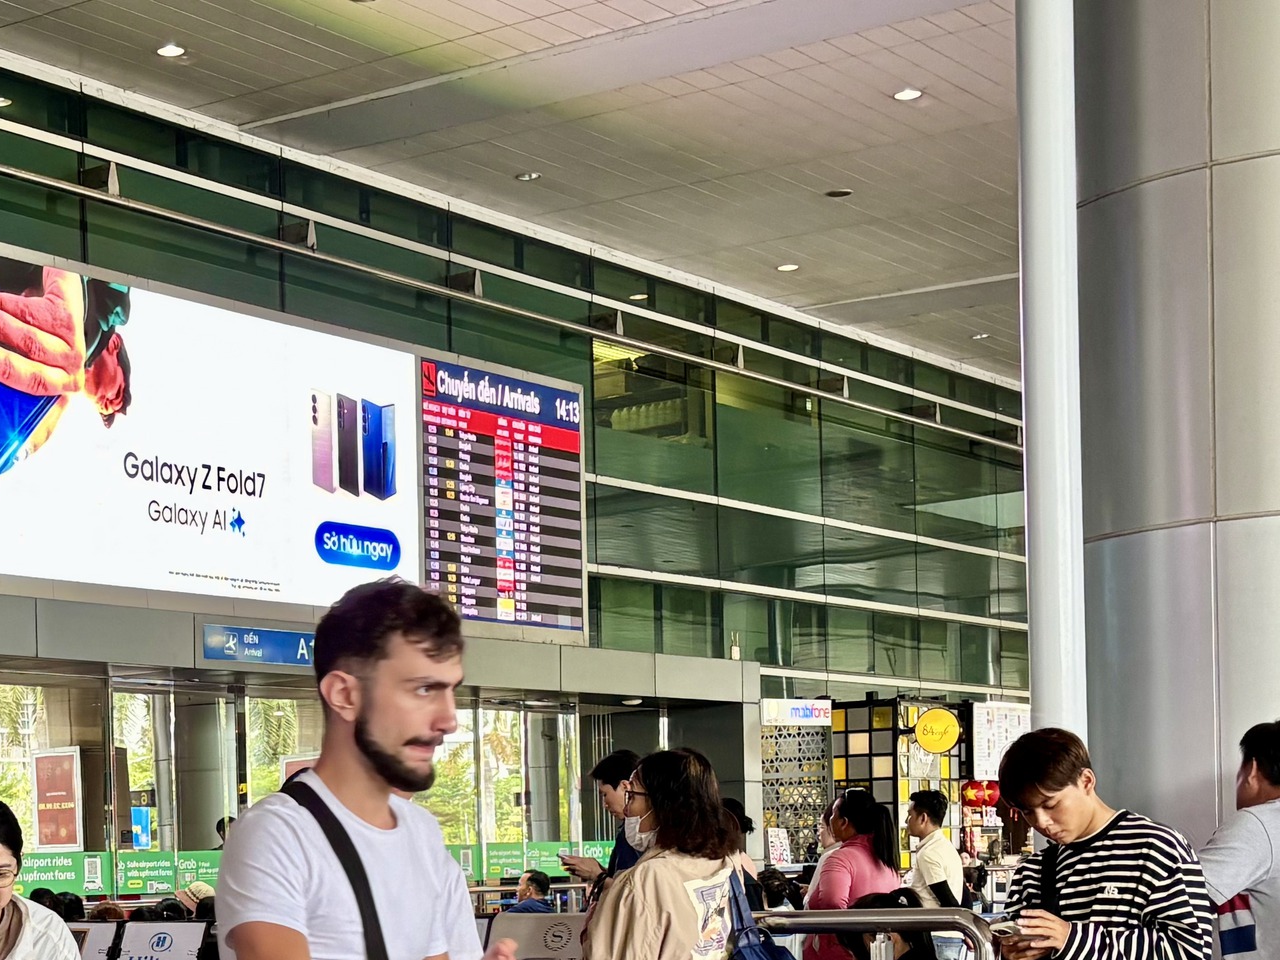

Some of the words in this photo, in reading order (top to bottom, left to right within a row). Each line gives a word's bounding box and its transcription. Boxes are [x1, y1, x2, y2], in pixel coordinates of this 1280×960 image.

[437, 370, 476, 403] Chuyến
[477, 375, 496, 405] đến
[503, 385, 540, 415] Arrivals
[555, 398, 580, 424] 14:13
[123, 451, 198, 495] Galaxy
[201, 464, 212, 491] Z
[217, 466, 266, 498] Fold7
[148, 500, 208, 535] Galaxy
[212, 509, 227, 531] AI
[364, 540, 393, 562] ngay
[244, 648, 263, 657] Arrival
[583, 844, 603, 858] Grab
[23, 856, 52, 869] airport
[52, 856, 73, 867] rides
[179, 858, 197, 870] Grab
[23, 870, 54, 883] upfront
[55, 870, 76, 880] fares
